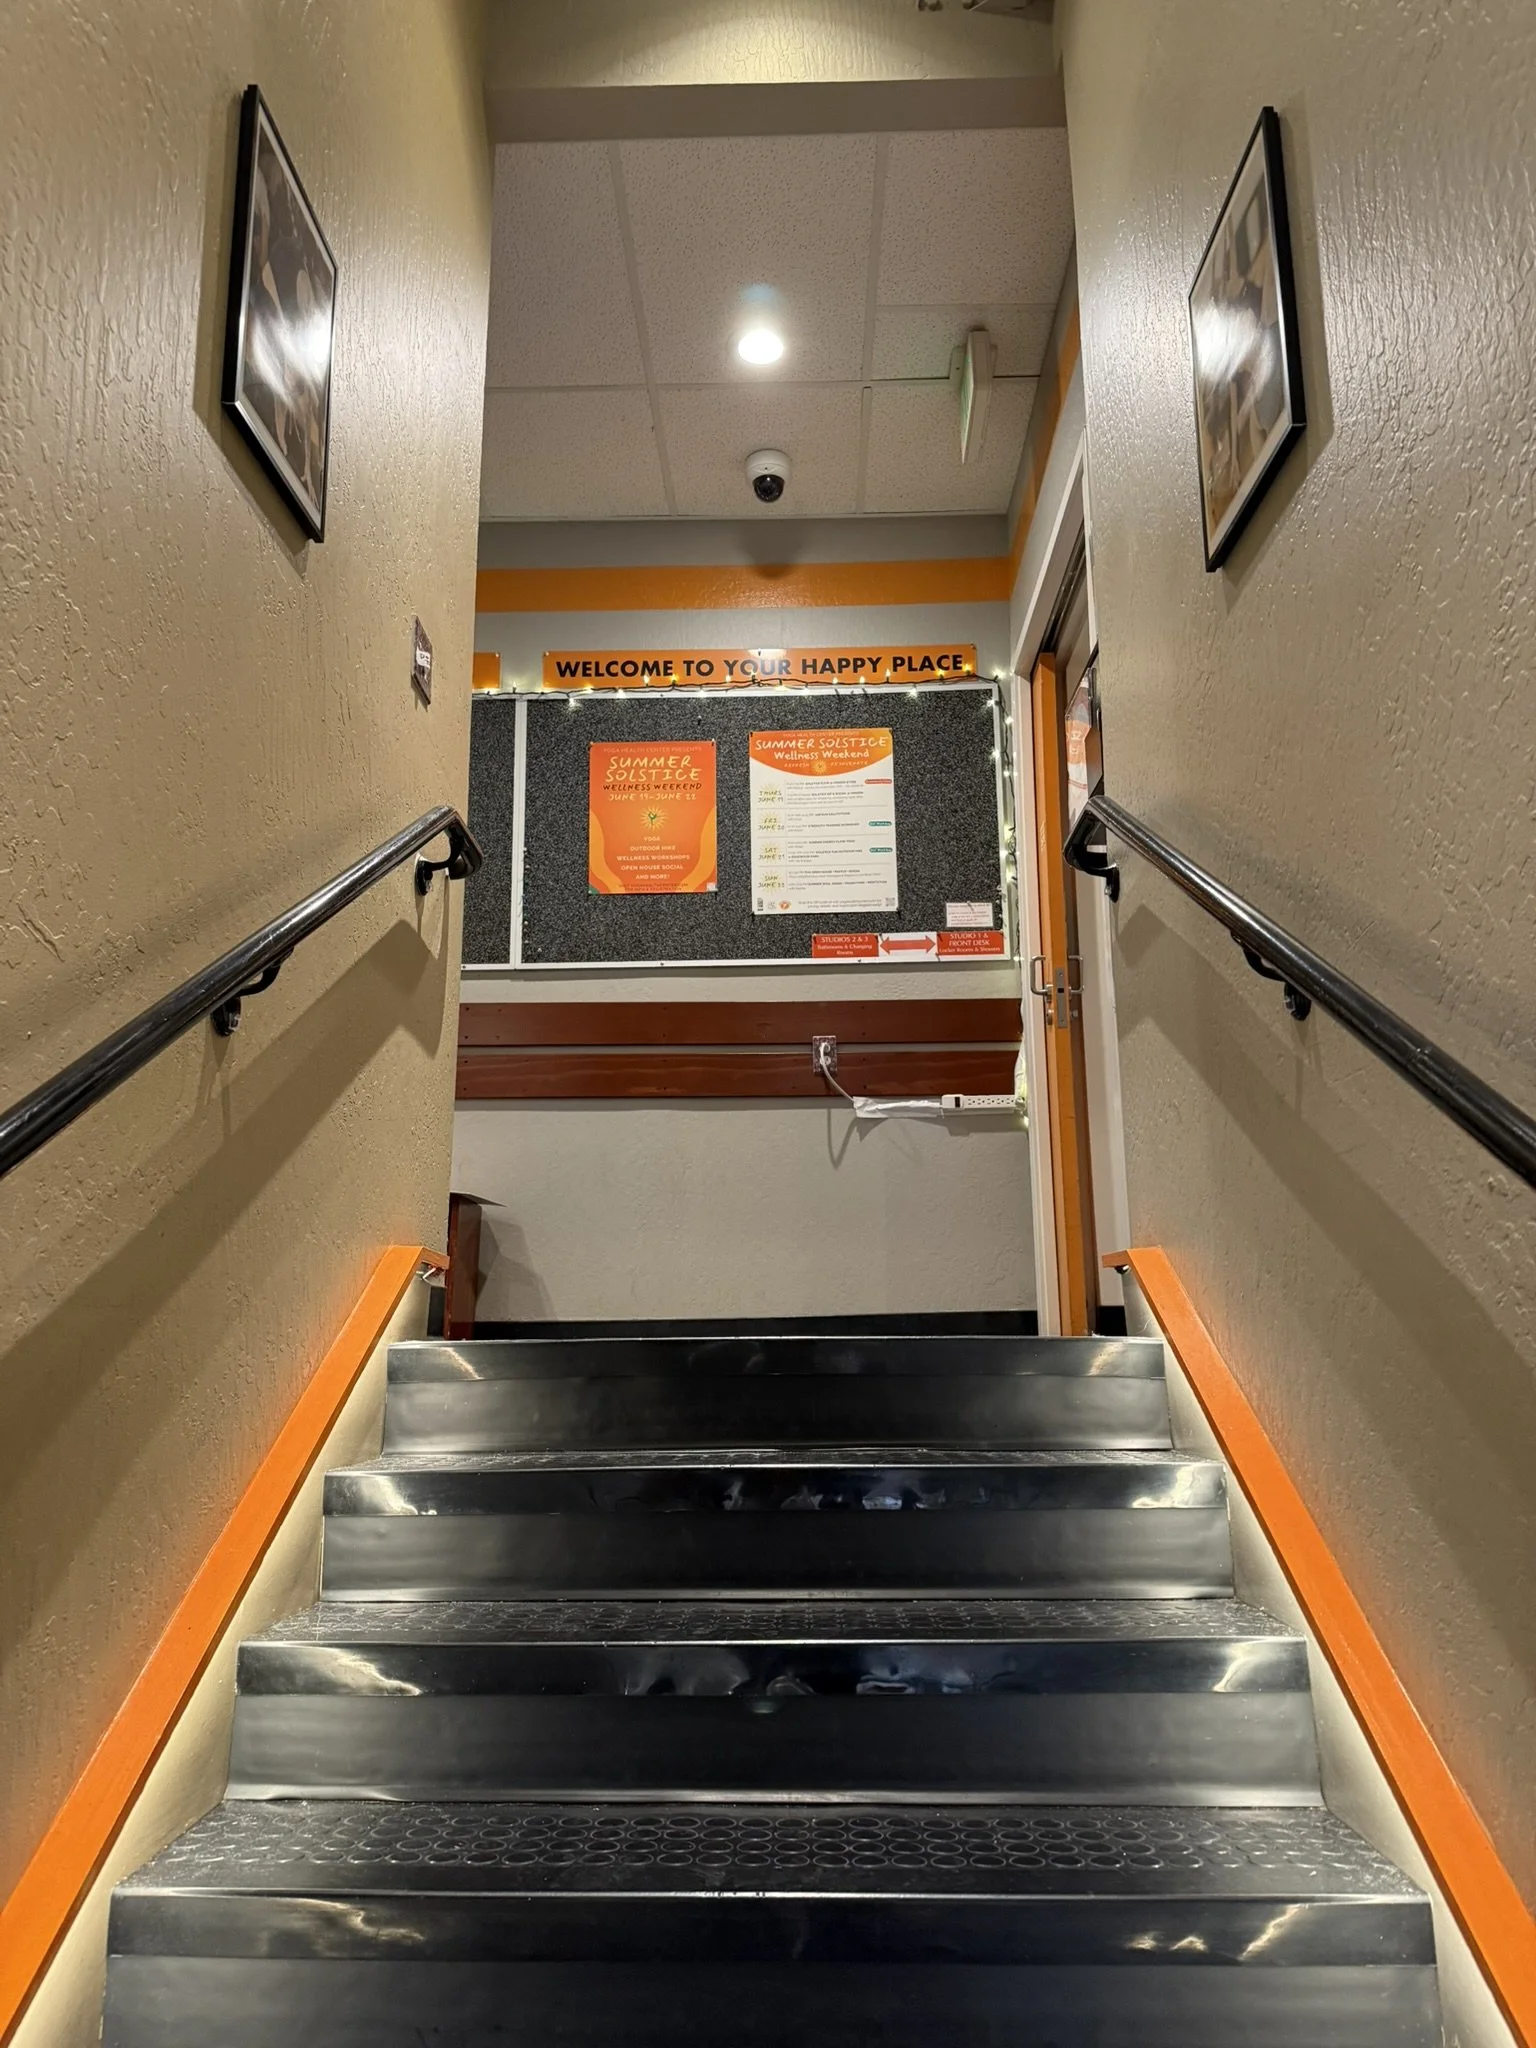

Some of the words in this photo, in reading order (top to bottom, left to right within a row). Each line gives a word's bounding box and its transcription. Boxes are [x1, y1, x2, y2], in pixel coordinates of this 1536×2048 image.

[556, 660, 673, 677] WELCOME
[683, 660, 714, 677] TO
[723, 659, 792, 677] YOUR
[801, 656, 882, 675] HAPPY
[892, 654, 963, 672] PLACE
[755, 738, 815, 750] SUMMER
[818, 736, 889, 750] SOLSTICE
[774, 751, 819, 760] Wellness
[822, 749, 870, 759] Weekend
[609, 755, 692, 770] SUMMER
[605, 768, 702, 783] SOLSTICE
[603, 783, 651, 791] WELLNESS
[653, 782, 702, 791] WEEKEND
[609, 793, 636, 801] JUNE
